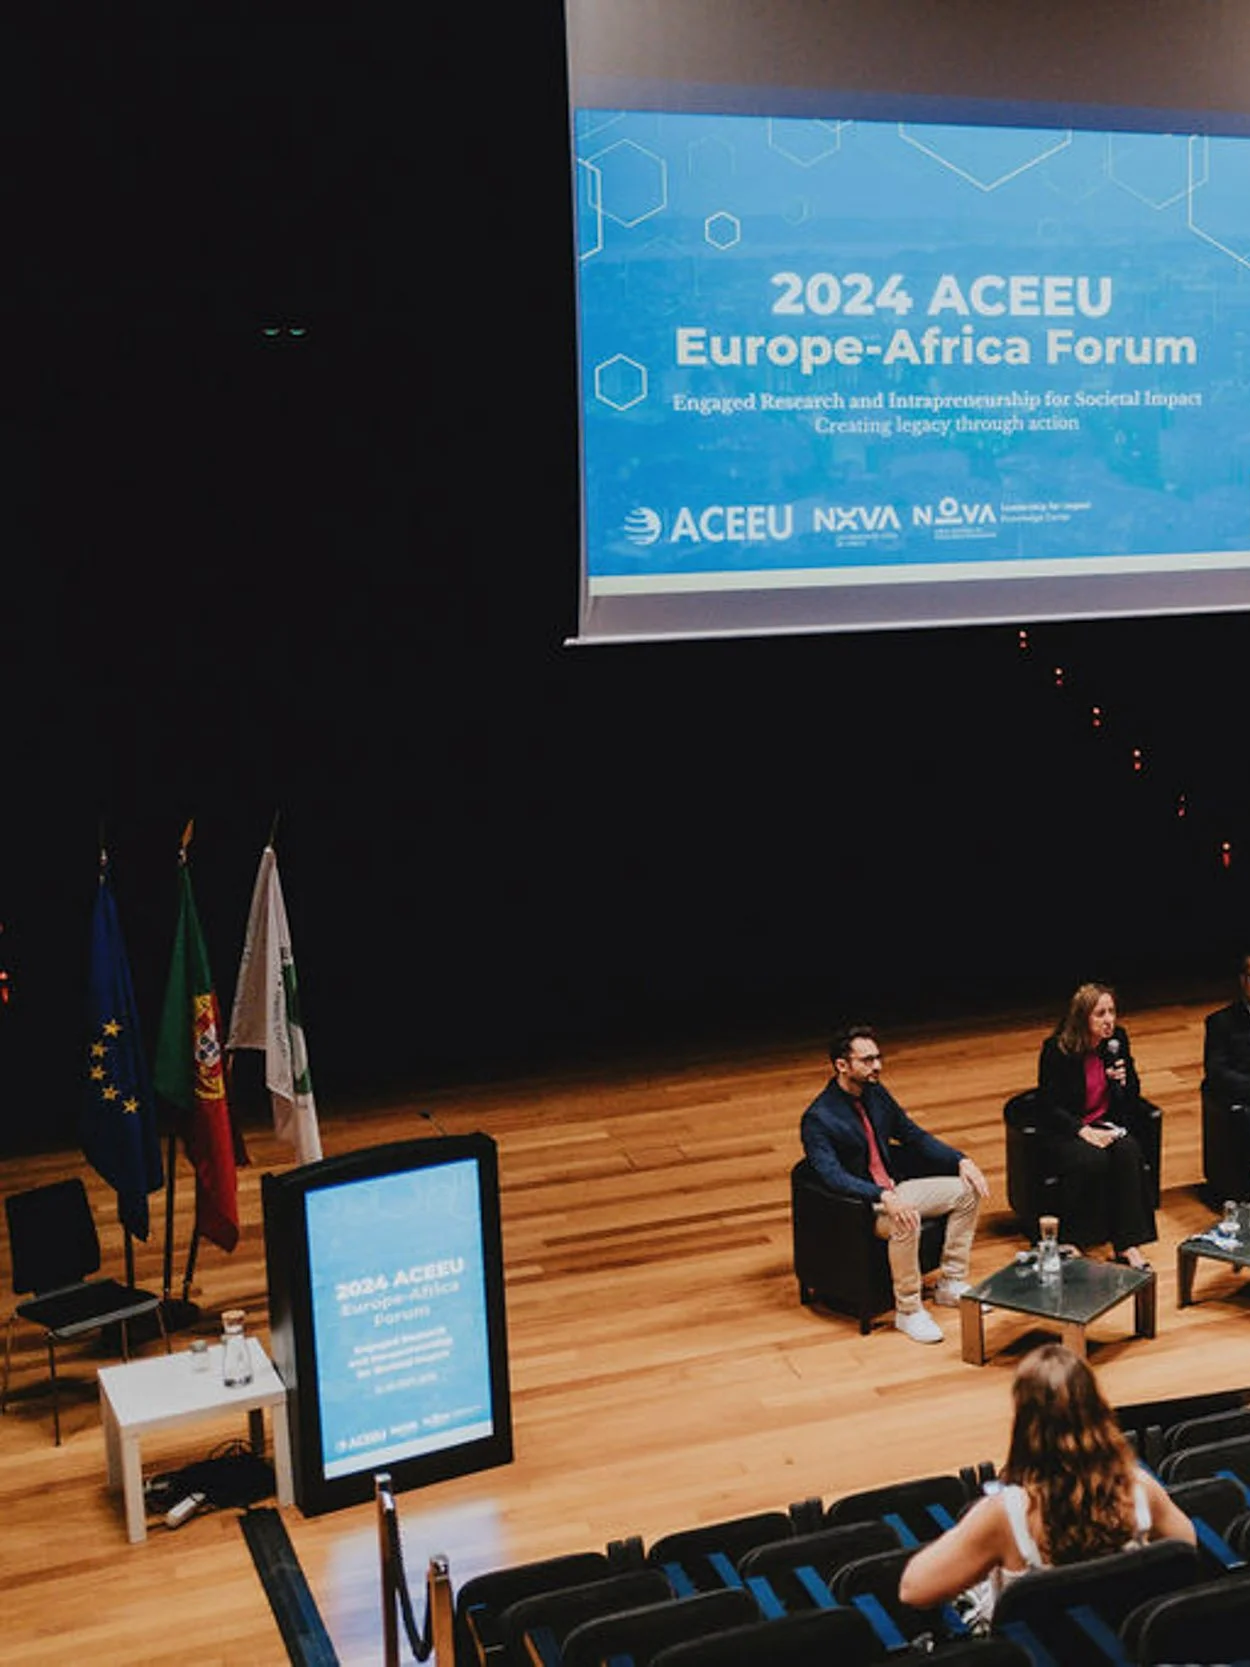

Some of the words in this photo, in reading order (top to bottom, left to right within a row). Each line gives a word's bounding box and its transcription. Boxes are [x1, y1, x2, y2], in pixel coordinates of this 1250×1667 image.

[770, 272, 913, 316] 2024
[927, 274, 1113, 317] ACEEU
[675, 324, 1031, 375] Europe-Africa
[1046, 328, 1198, 365] Forum
[672, 392, 756, 415] Engaged
[760, 391, 844, 410] Research
[848, 391, 883, 409] and
[888, 390, 1041, 414] Intrapreneurship
[1044, 389, 1070, 406] for
[1075, 390, 1141, 407] Societal
[1144, 390, 1203, 410] Impact
[814, 416, 892, 438] Creating
[896, 415, 950, 437] legacy
[956, 415, 1024, 436] through
[1027, 415, 1080, 431] action
[669, 504, 794, 543] ACEEU
[335, 1274, 389, 1300] 2024
[393, 1256, 465, 1288] ACEEU
